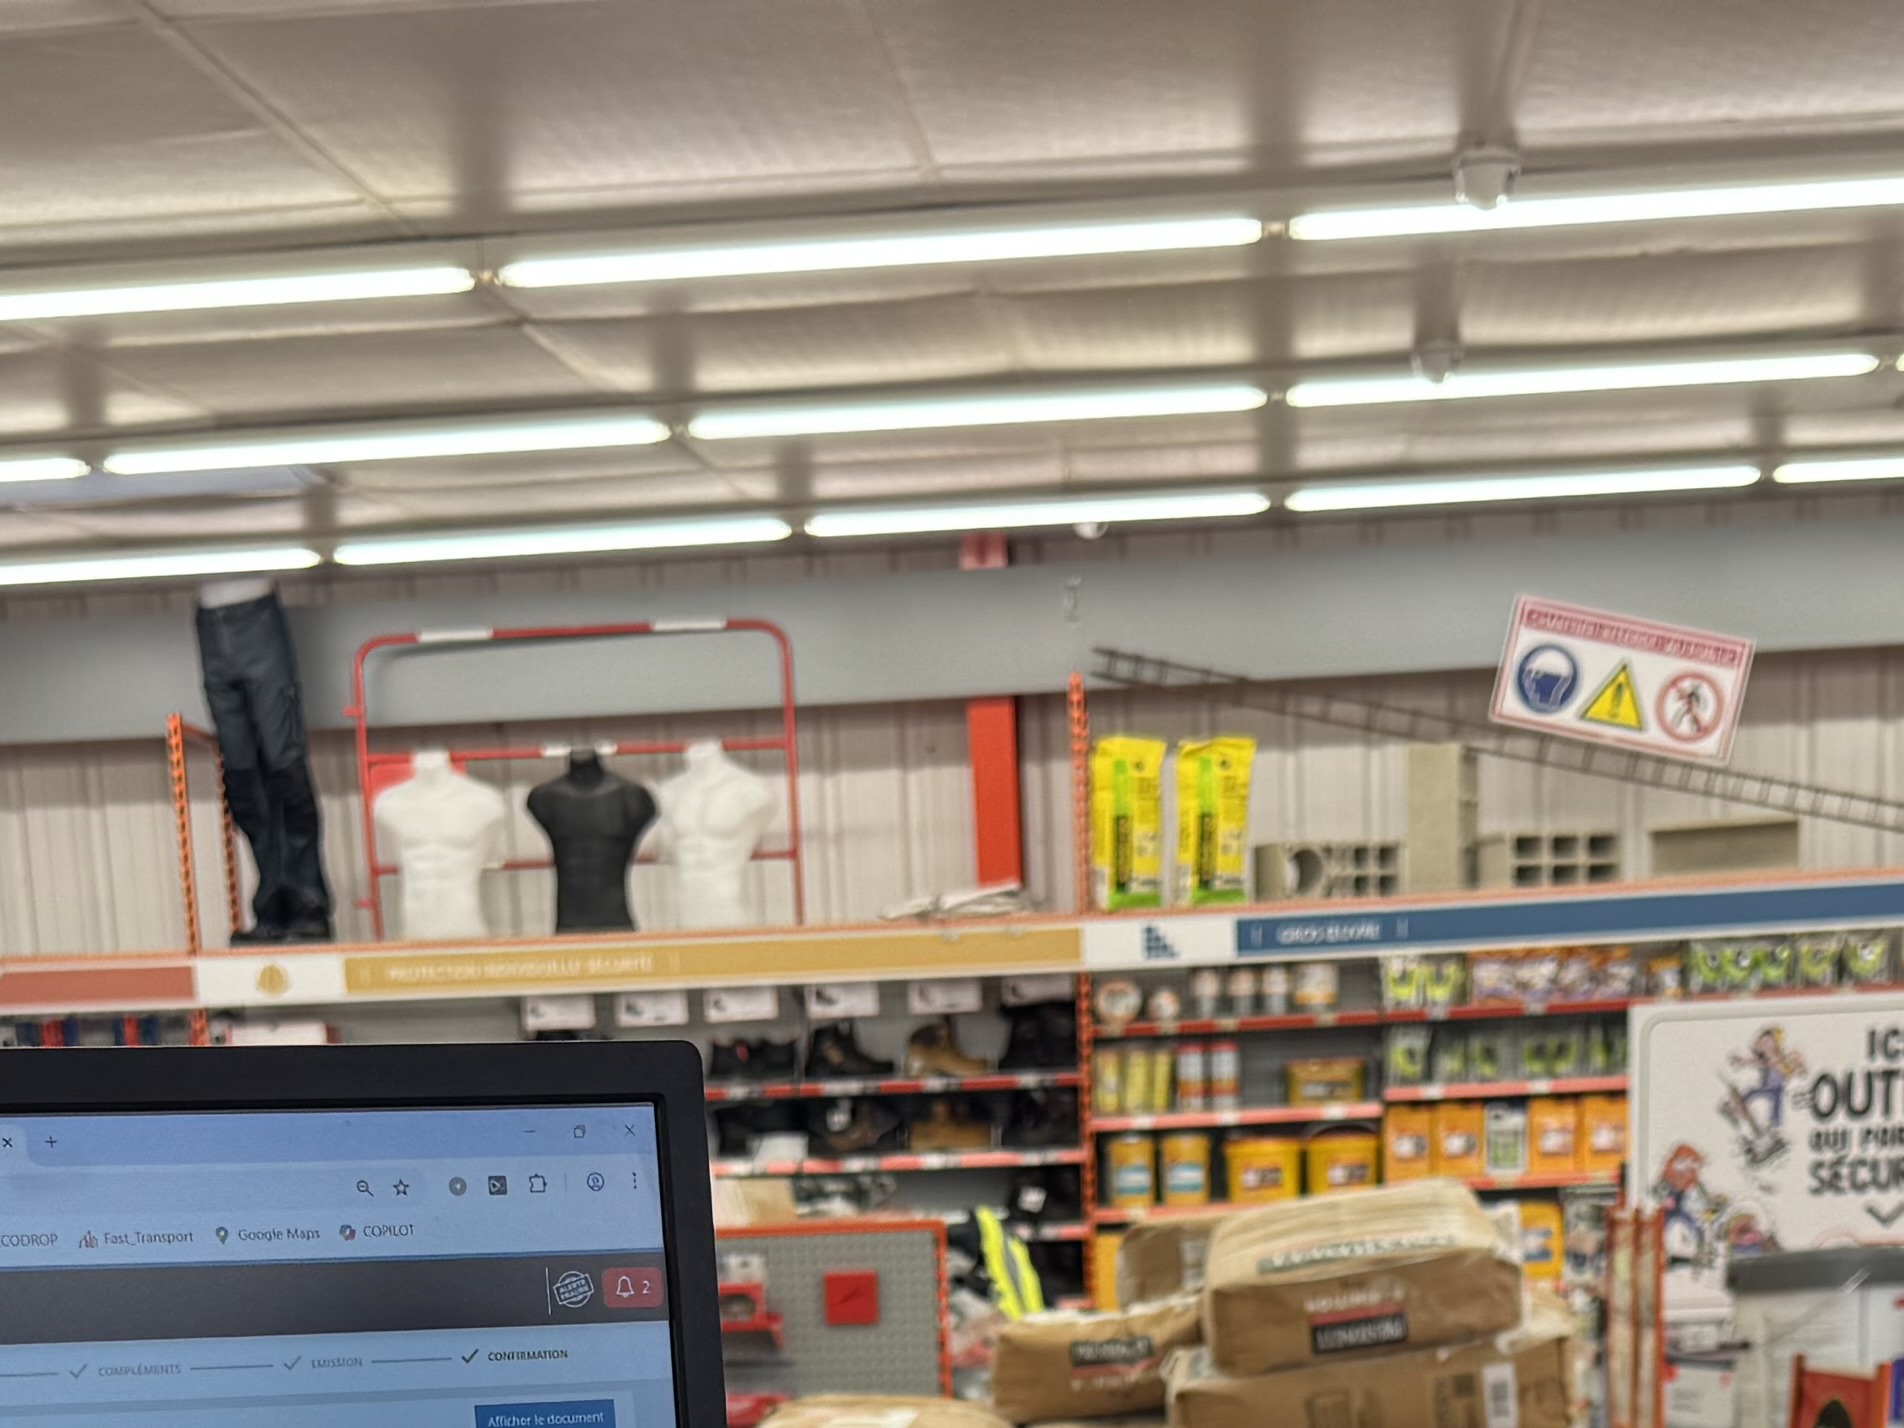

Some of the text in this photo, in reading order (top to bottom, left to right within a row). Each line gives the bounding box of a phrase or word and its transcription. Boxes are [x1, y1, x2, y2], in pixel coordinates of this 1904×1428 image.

[1808, 1129, 1849, 1152] QUI
[238, 1225, 320, 1245] Google Maps
[363, 1223, 415, 1240] COPILOT
